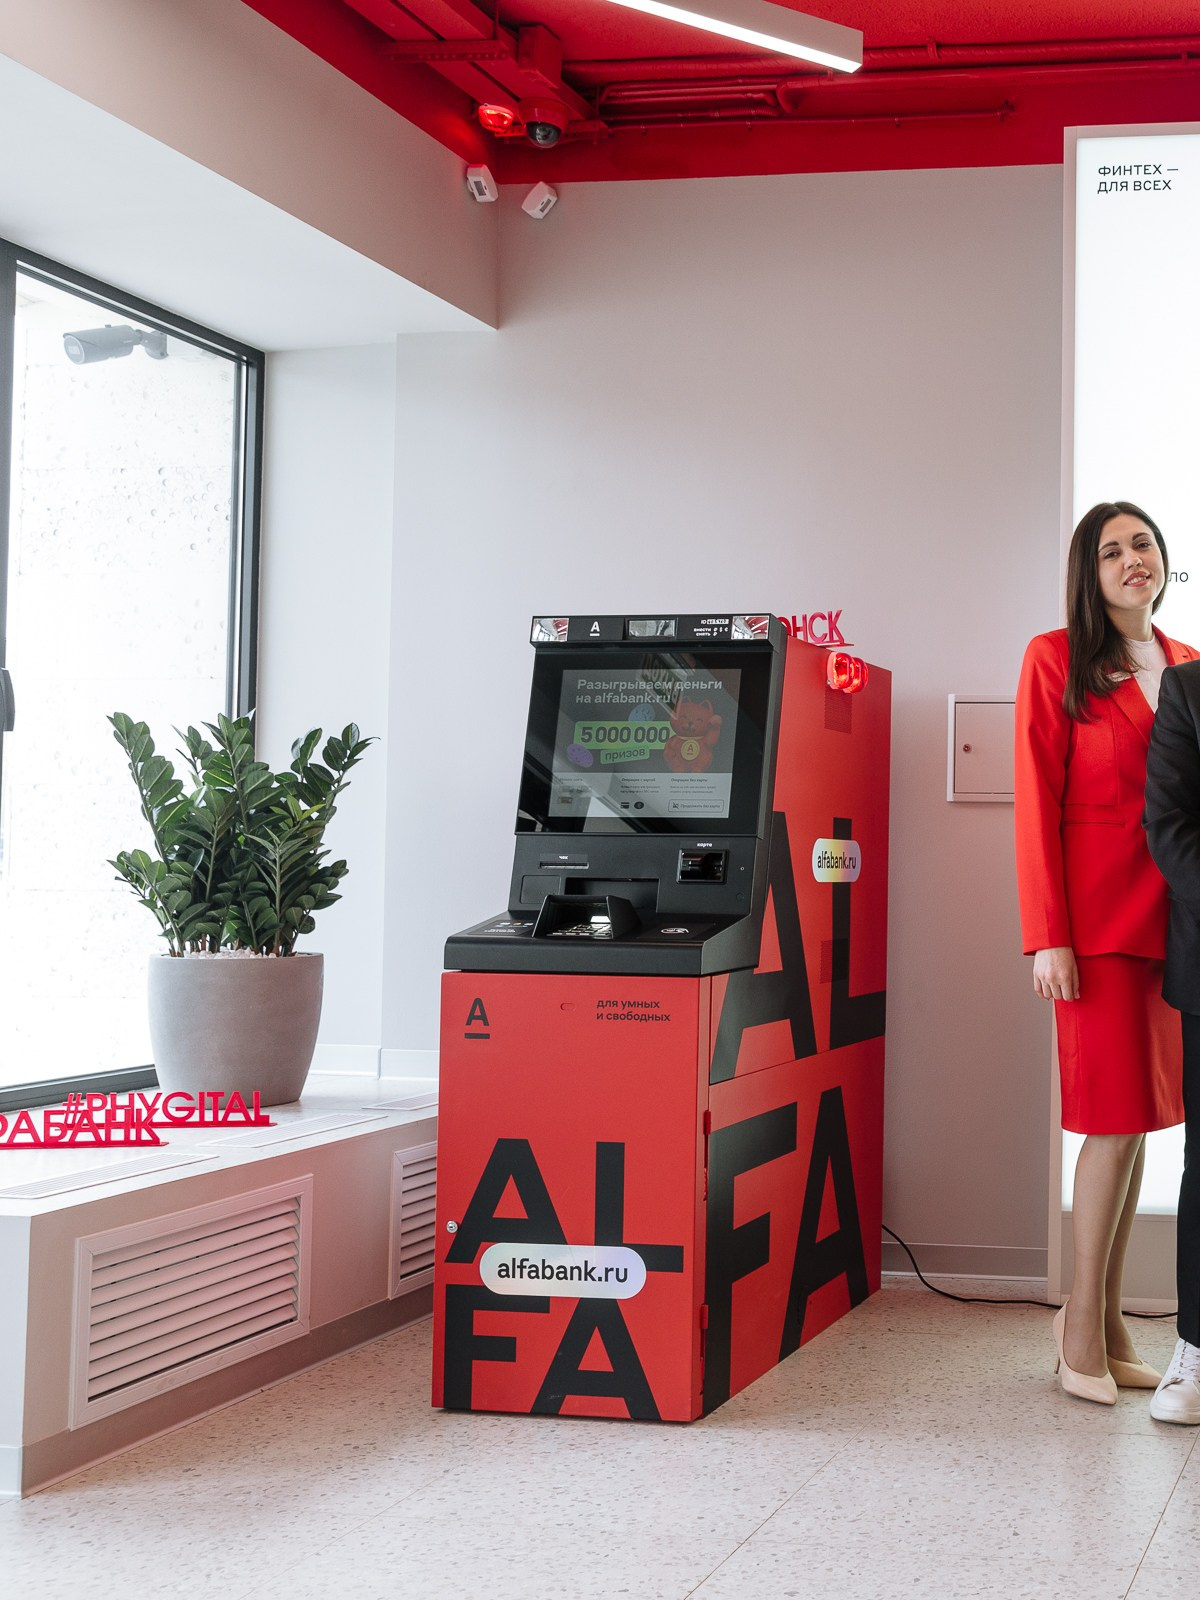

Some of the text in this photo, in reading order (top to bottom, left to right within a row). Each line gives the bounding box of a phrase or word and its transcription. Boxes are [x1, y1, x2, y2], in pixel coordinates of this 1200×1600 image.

[1098, 164, 1162, 176] ФИНТЕХ
[1097, 179, 1172, 194] ДЛЯ ВСЕХ
[577, 679, 723, 692] Разыгрываем деньги
[576, 693, 671, 704] на alfabank.ru
[604, 748, 646, 762] призов
[817, 850, 857, 870] alfabank.ru
[596, 1000, 660, 1010] для умных
[606, 1011, 671, 1022] свободных
[497, 1257, 629, 1284] alfabank.ru
